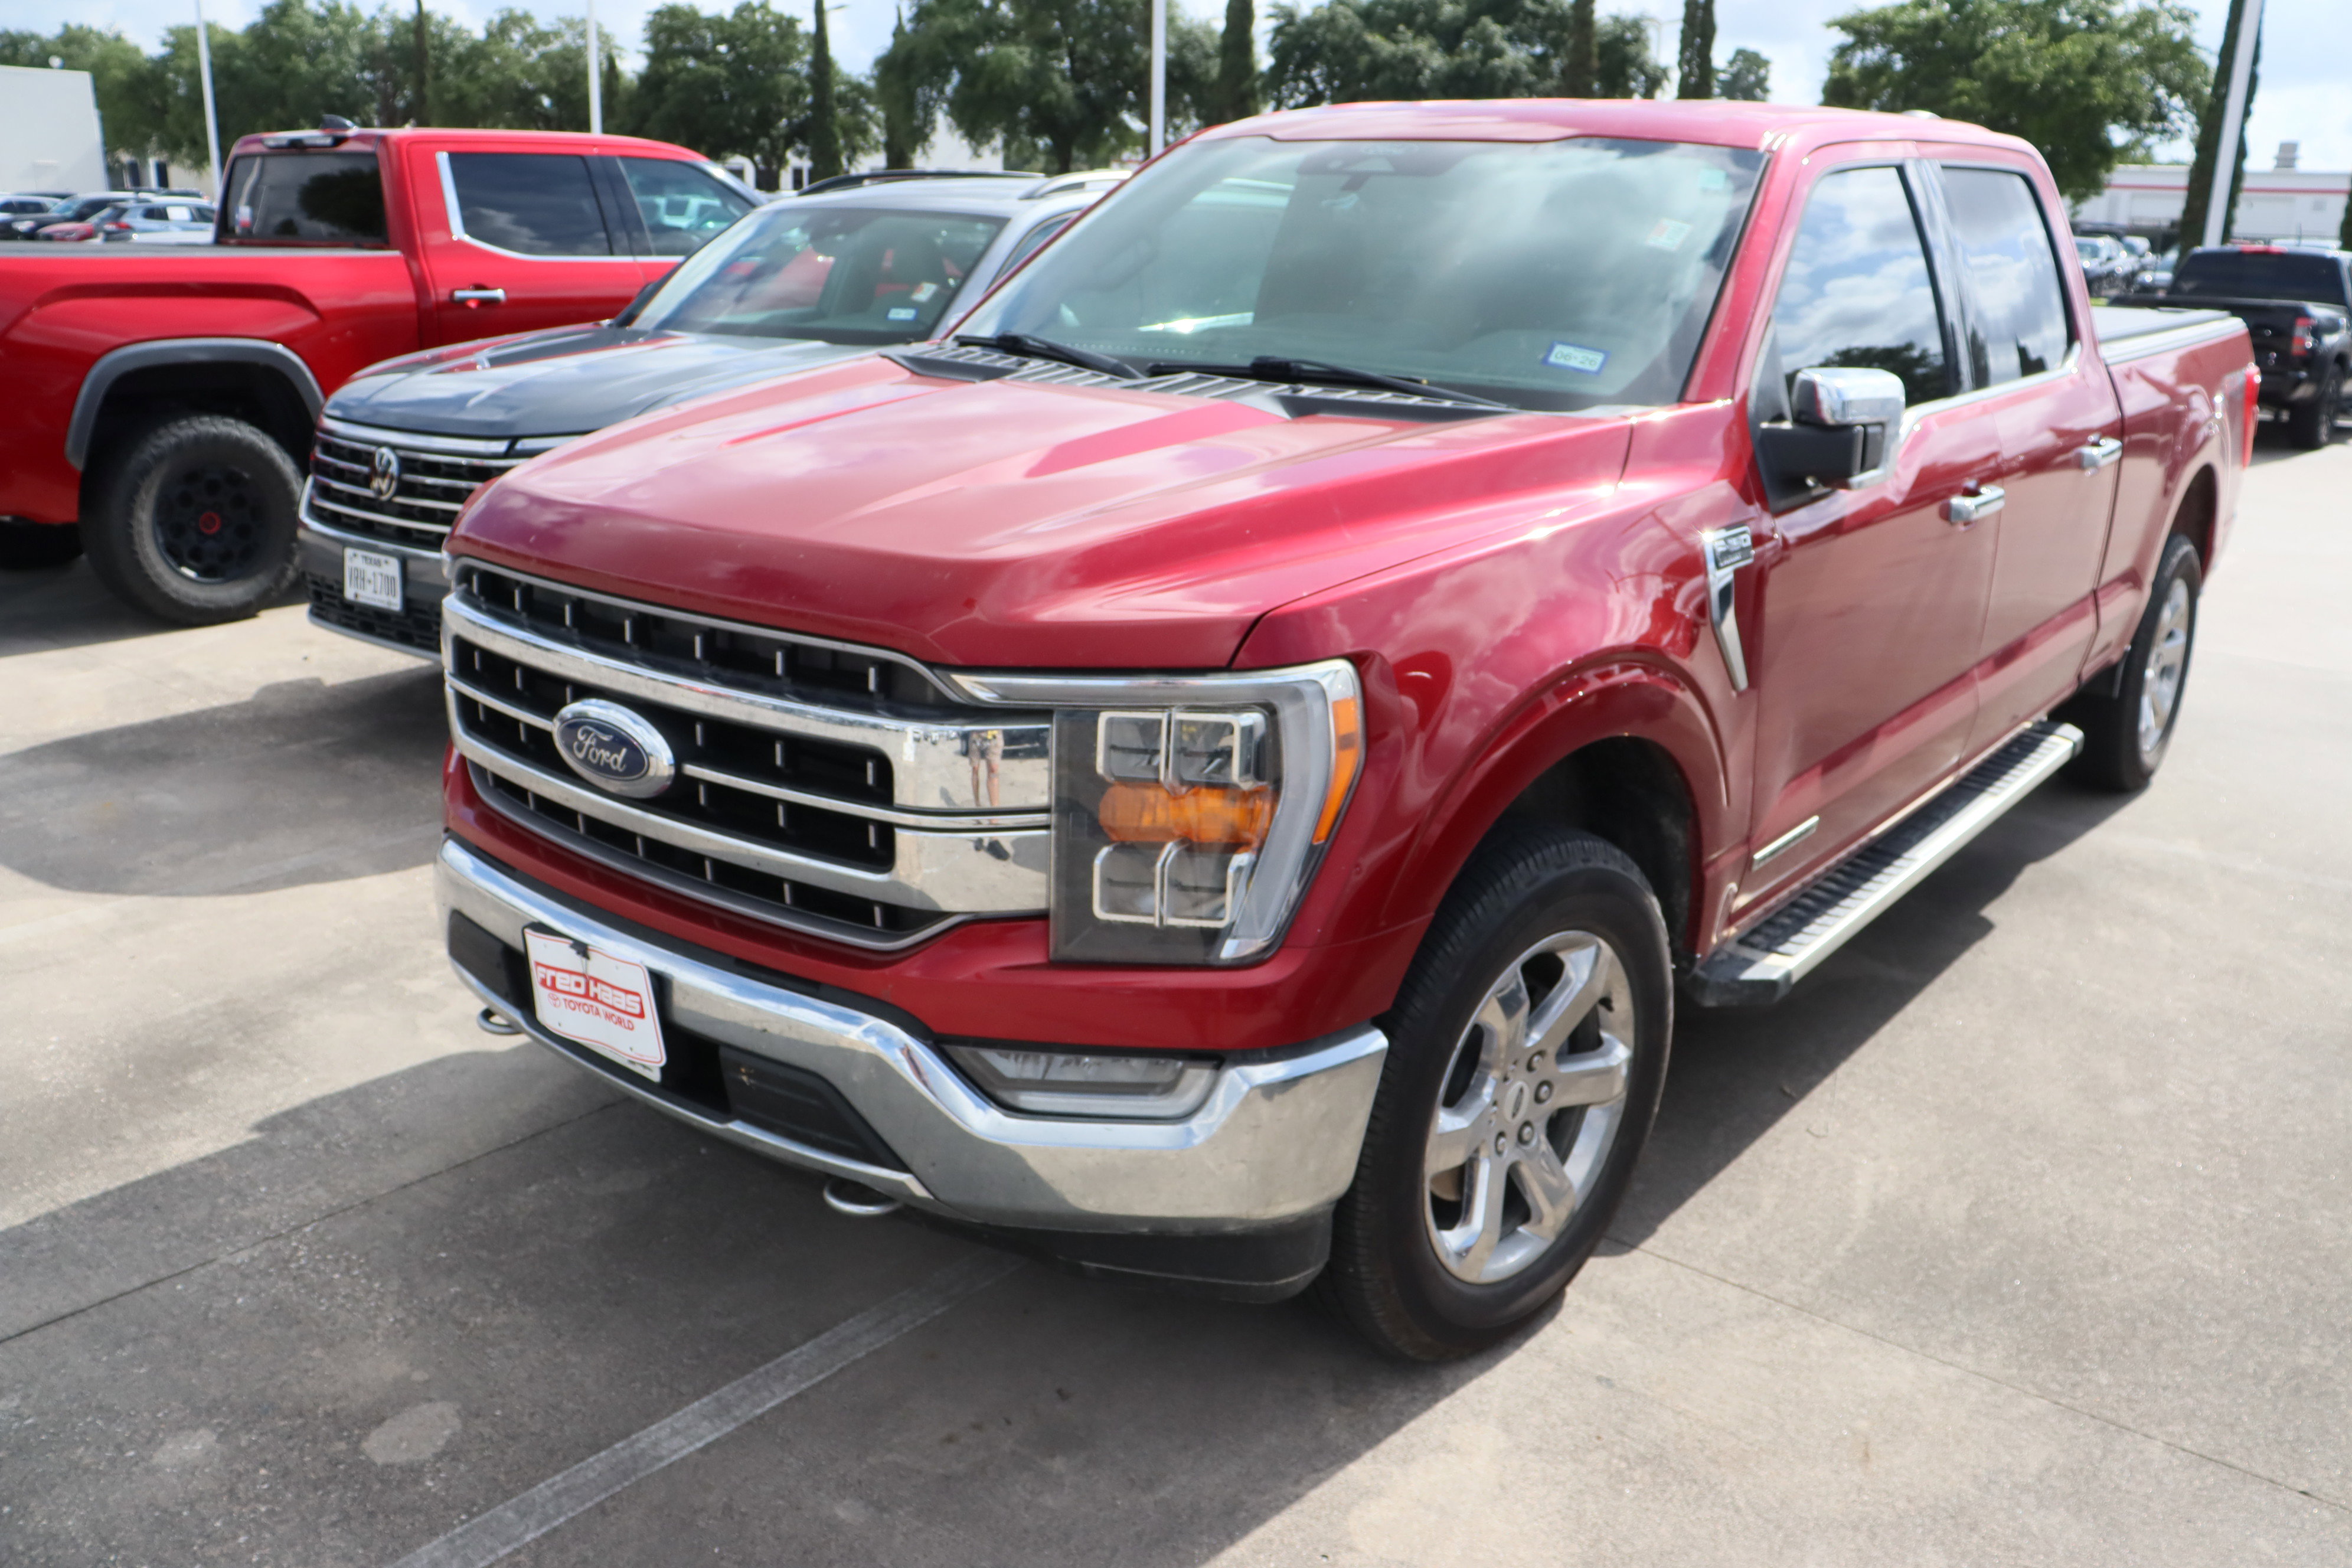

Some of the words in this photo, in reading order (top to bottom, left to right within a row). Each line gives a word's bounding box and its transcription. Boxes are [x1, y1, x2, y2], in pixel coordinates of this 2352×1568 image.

[361, 555, 382, 567] TEXAS
[573, 726, 627, 772] Ford
[563, 998, 601, 1016] TOYOTA
[603, 1010, 635, 1031] WORLD
